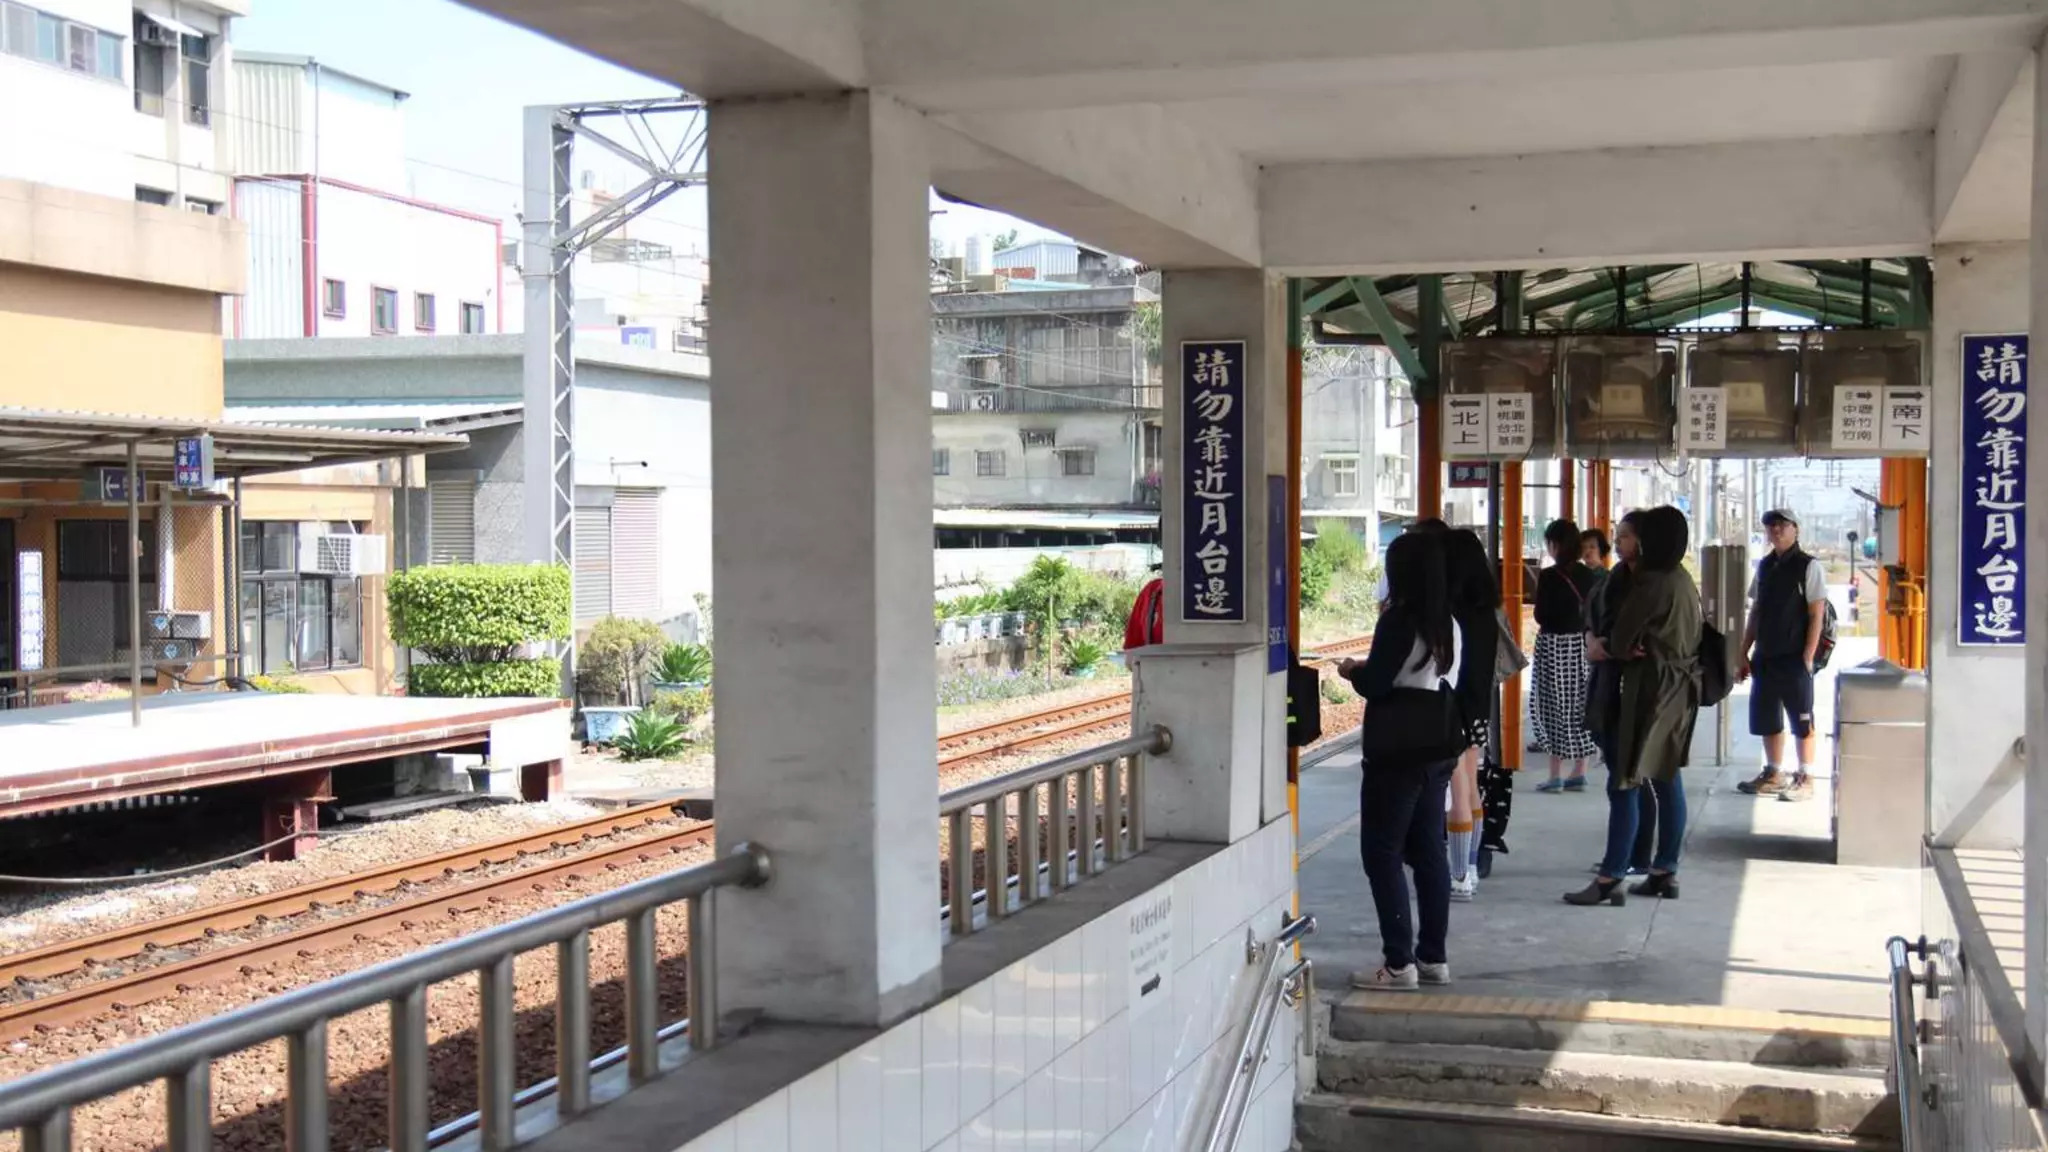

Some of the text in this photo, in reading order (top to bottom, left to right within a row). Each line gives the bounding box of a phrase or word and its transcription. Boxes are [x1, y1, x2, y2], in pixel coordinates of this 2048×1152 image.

[1452, 411, 1480, 444] 北上
[1843, 418, 1872, 428] 新竹
[1892, 405, 1922, 439] 南下
[1193, 351, 1233, 614] 請勿靠近月台邊
[1974, 343, 2027, 638] 請勿靠近月台邊
